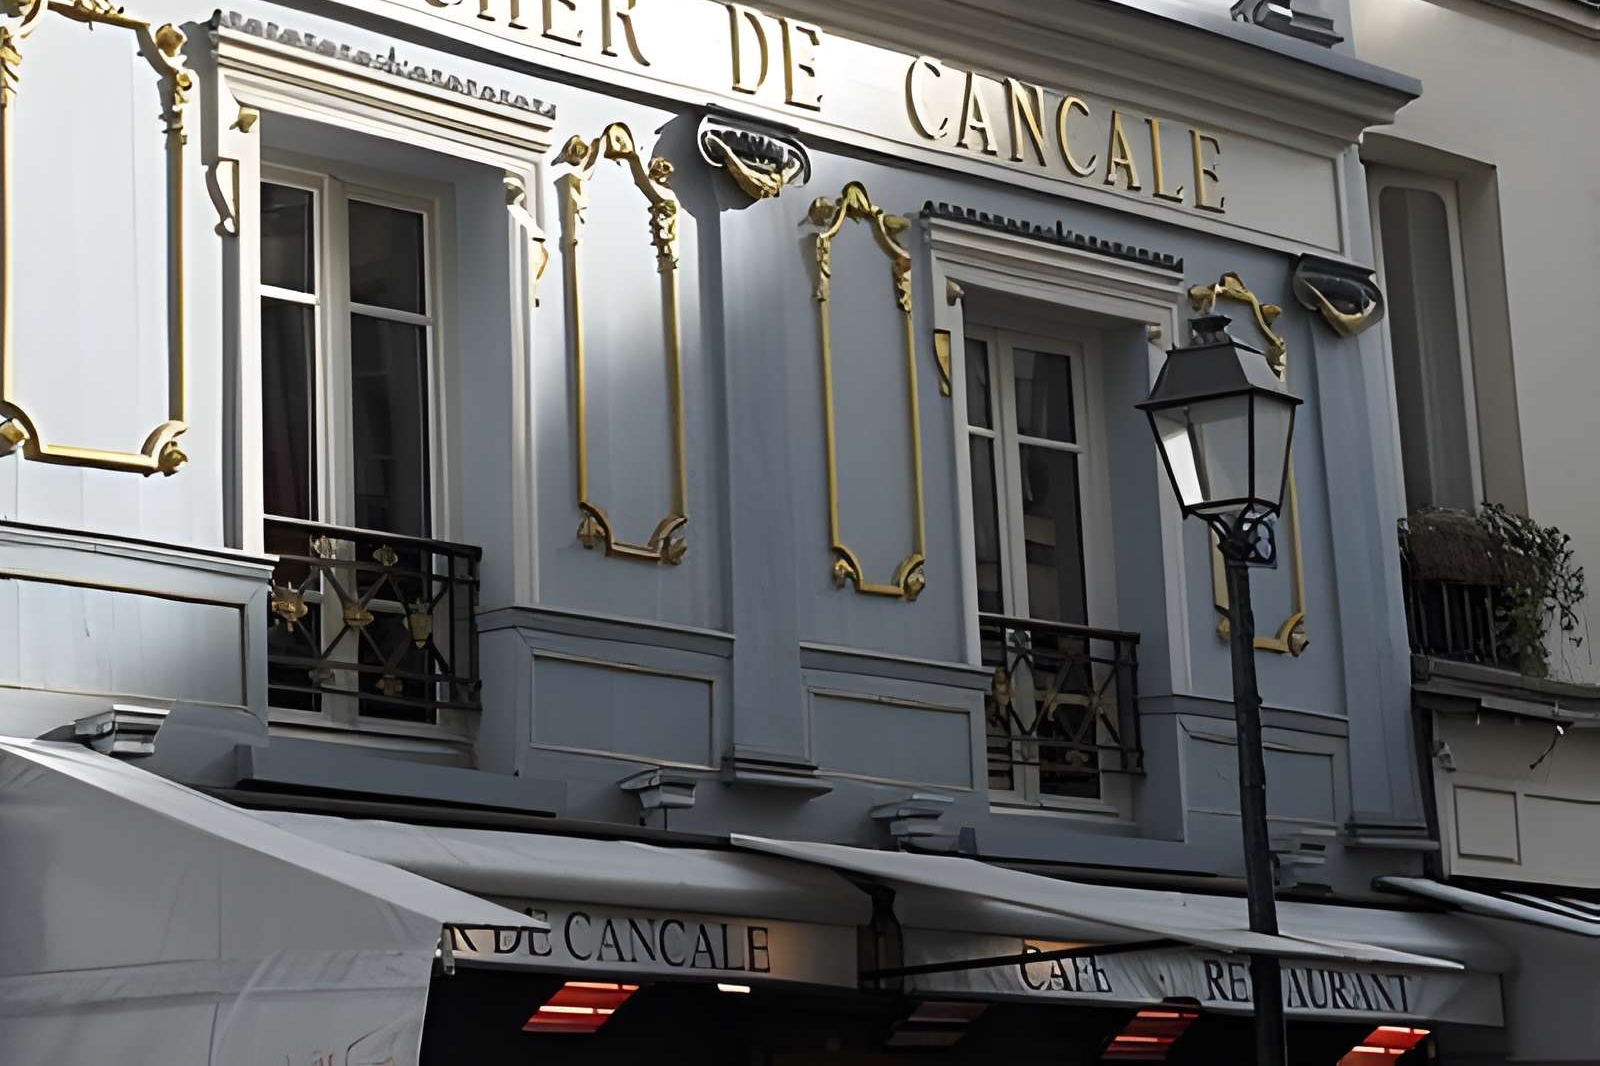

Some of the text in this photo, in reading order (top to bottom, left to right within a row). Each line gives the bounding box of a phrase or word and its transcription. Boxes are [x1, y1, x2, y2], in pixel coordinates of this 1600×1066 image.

[727, 3, 823, 112] DE
[905, 55, 1226, 214] CANCALE
[564, 911, 771, 972] CANCALE
[1203, 959, 1411, 1012] REAURANT
